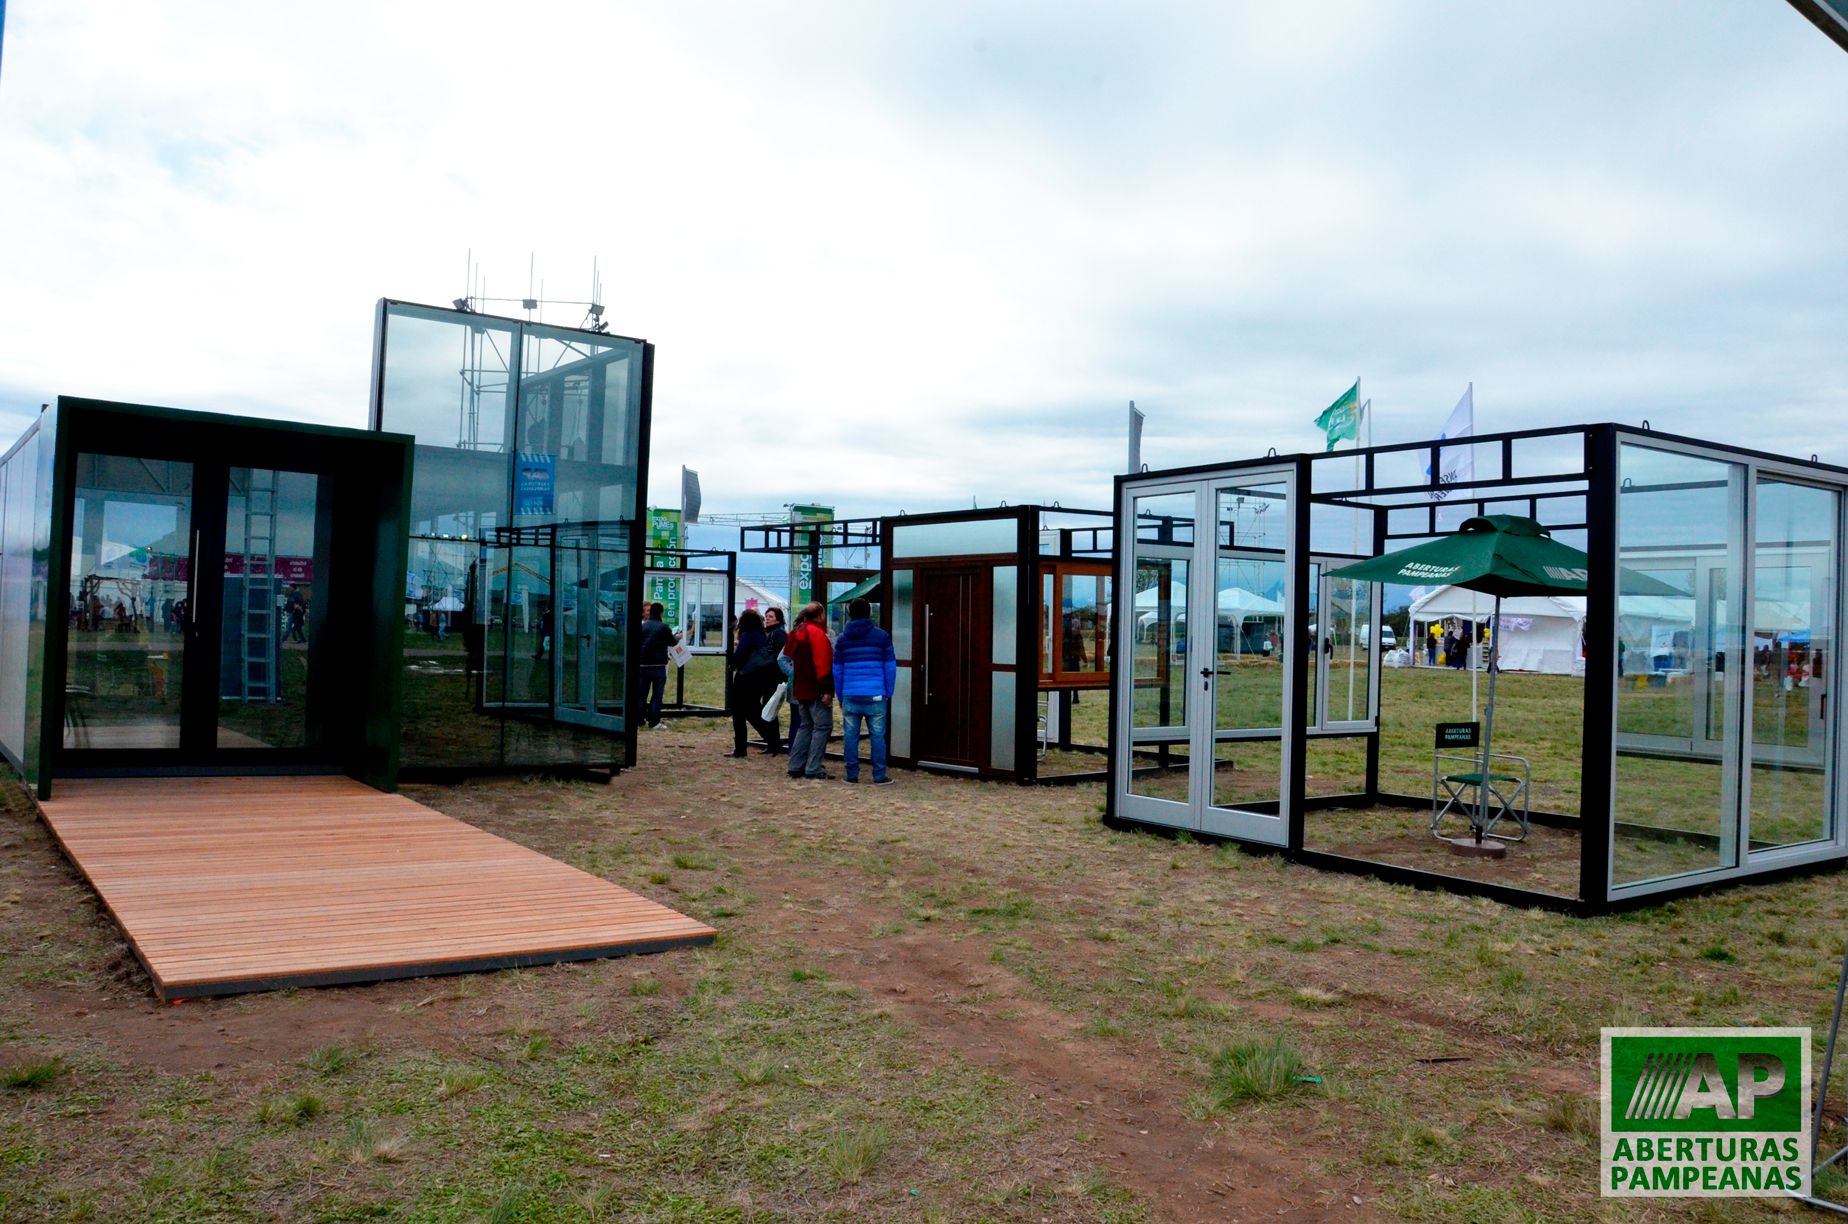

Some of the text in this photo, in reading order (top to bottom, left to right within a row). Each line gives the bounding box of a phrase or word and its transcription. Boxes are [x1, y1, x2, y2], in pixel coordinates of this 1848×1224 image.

[667, 537, 677, 617] en procción
[1397, 568, 1453, 578] PAMPEANAS
[1405, 562, 1461, 573] ABERTURAS
[654, 561, 664, 600] Pama
